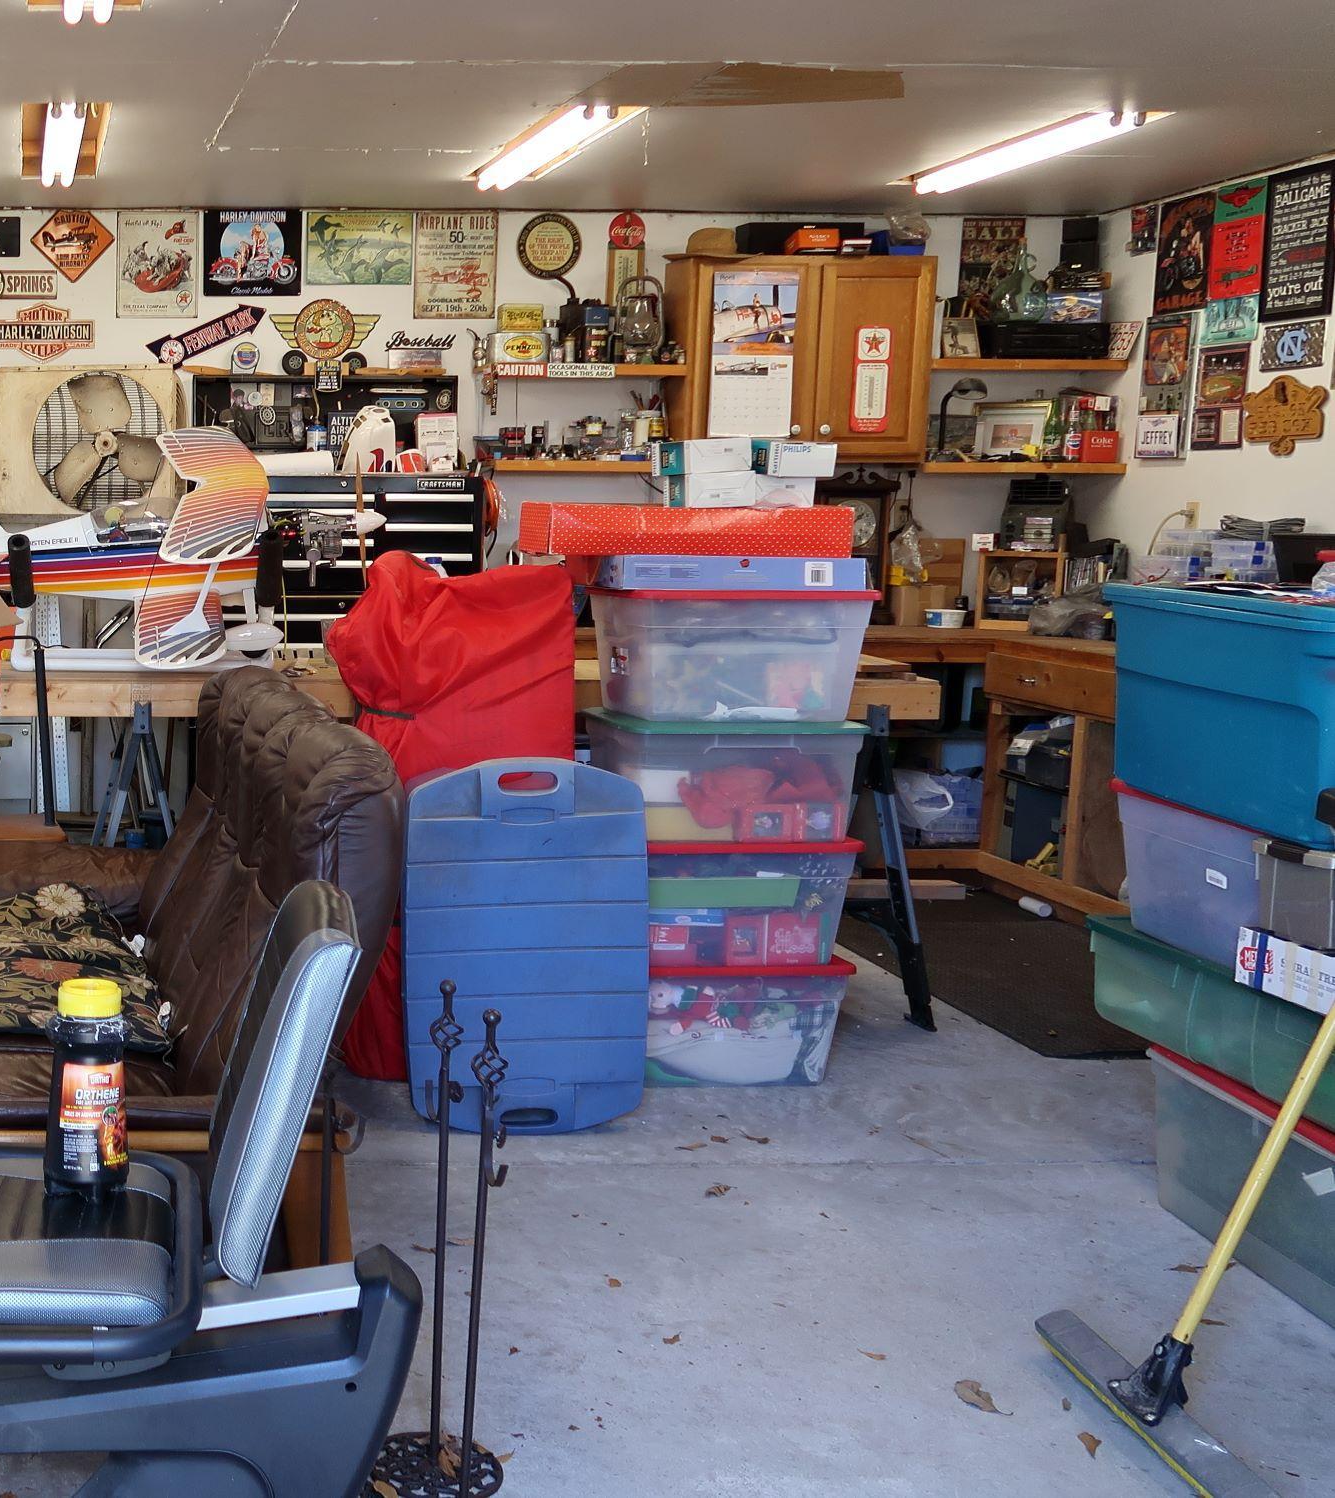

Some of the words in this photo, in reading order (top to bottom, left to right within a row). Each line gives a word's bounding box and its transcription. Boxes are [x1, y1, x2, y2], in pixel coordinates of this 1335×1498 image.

[1274, 182, 1331, 209] BALLGAME
[54, 214, 91, 226] CAUTION
[219, 211, 286, 223] HARLEY-DAVIDSON
[419, 216, 463, 230] AIRPLANE
[469, 216, 495, 230] RIDES
[1272, 220, 1308, 236] CRACKER
[1309, 215, 1329, 229] JACK
[964, 227, 1020, 240] BALL
[6, 275, 54, 293] SPRINGS
[1267, 283, 1301, 301] you're
[1303, 276, 1323, 293] out
[23, 307, 63, 321] MOTOR
[445, 304, 462, 312] 19th
[470, 304, 487, 312] 20th
[182, 320, 228, 354] FENWAY
[224, 307, 257, 334] PARK
[385, 330, 457, 350] Baseball
[24, 342, 65, 357] CYCLES
[497, 364, 544, 376] CAUTION
[330, 416, 354, 426] ALTIT
[330, 425, 350, 435] AIRS
[1091, 436, 1114, 444] Coke
[1140, 430, 1173, 445] JEFFREY
[783, 445, 812, 453] PHILIPS
[772, 443, 780, 474] PHILIPS
[419, 480, 462, 489] CRAFTSMAN
[52, 537, 73, 545] EAGLE
[90, 1075, 111, 1085] ORTHO
[75, 1086, 120, 1100] ORTHENE
